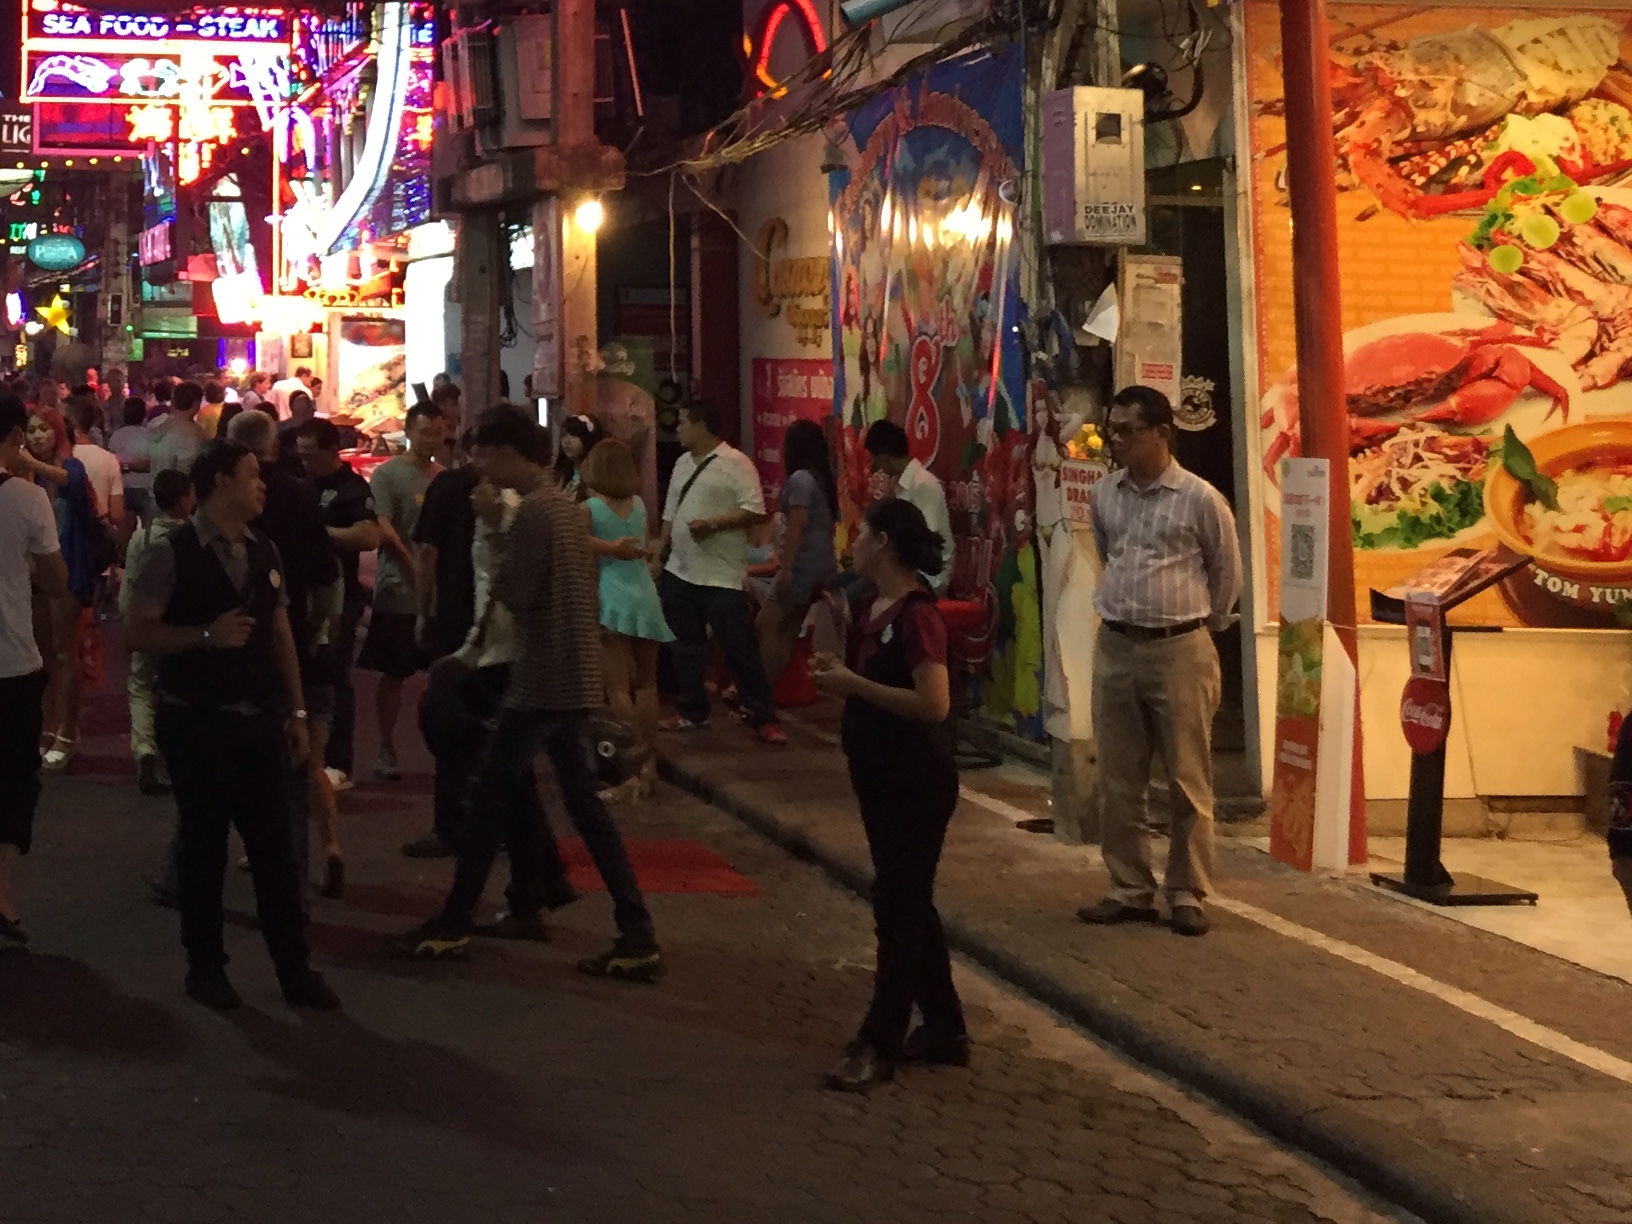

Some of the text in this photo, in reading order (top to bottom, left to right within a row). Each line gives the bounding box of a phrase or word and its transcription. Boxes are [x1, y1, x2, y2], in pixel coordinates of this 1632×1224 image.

[41, 14, 92, 36] SEA
[99, 14, 170, 38] FOOD
[197, 15, 280, 39] STEAK
[1, 114, 31, 123] THE
[1084, 204, 1134, 216] DEEJAY
[1084, 214, 1138, 230] DOMINATION
